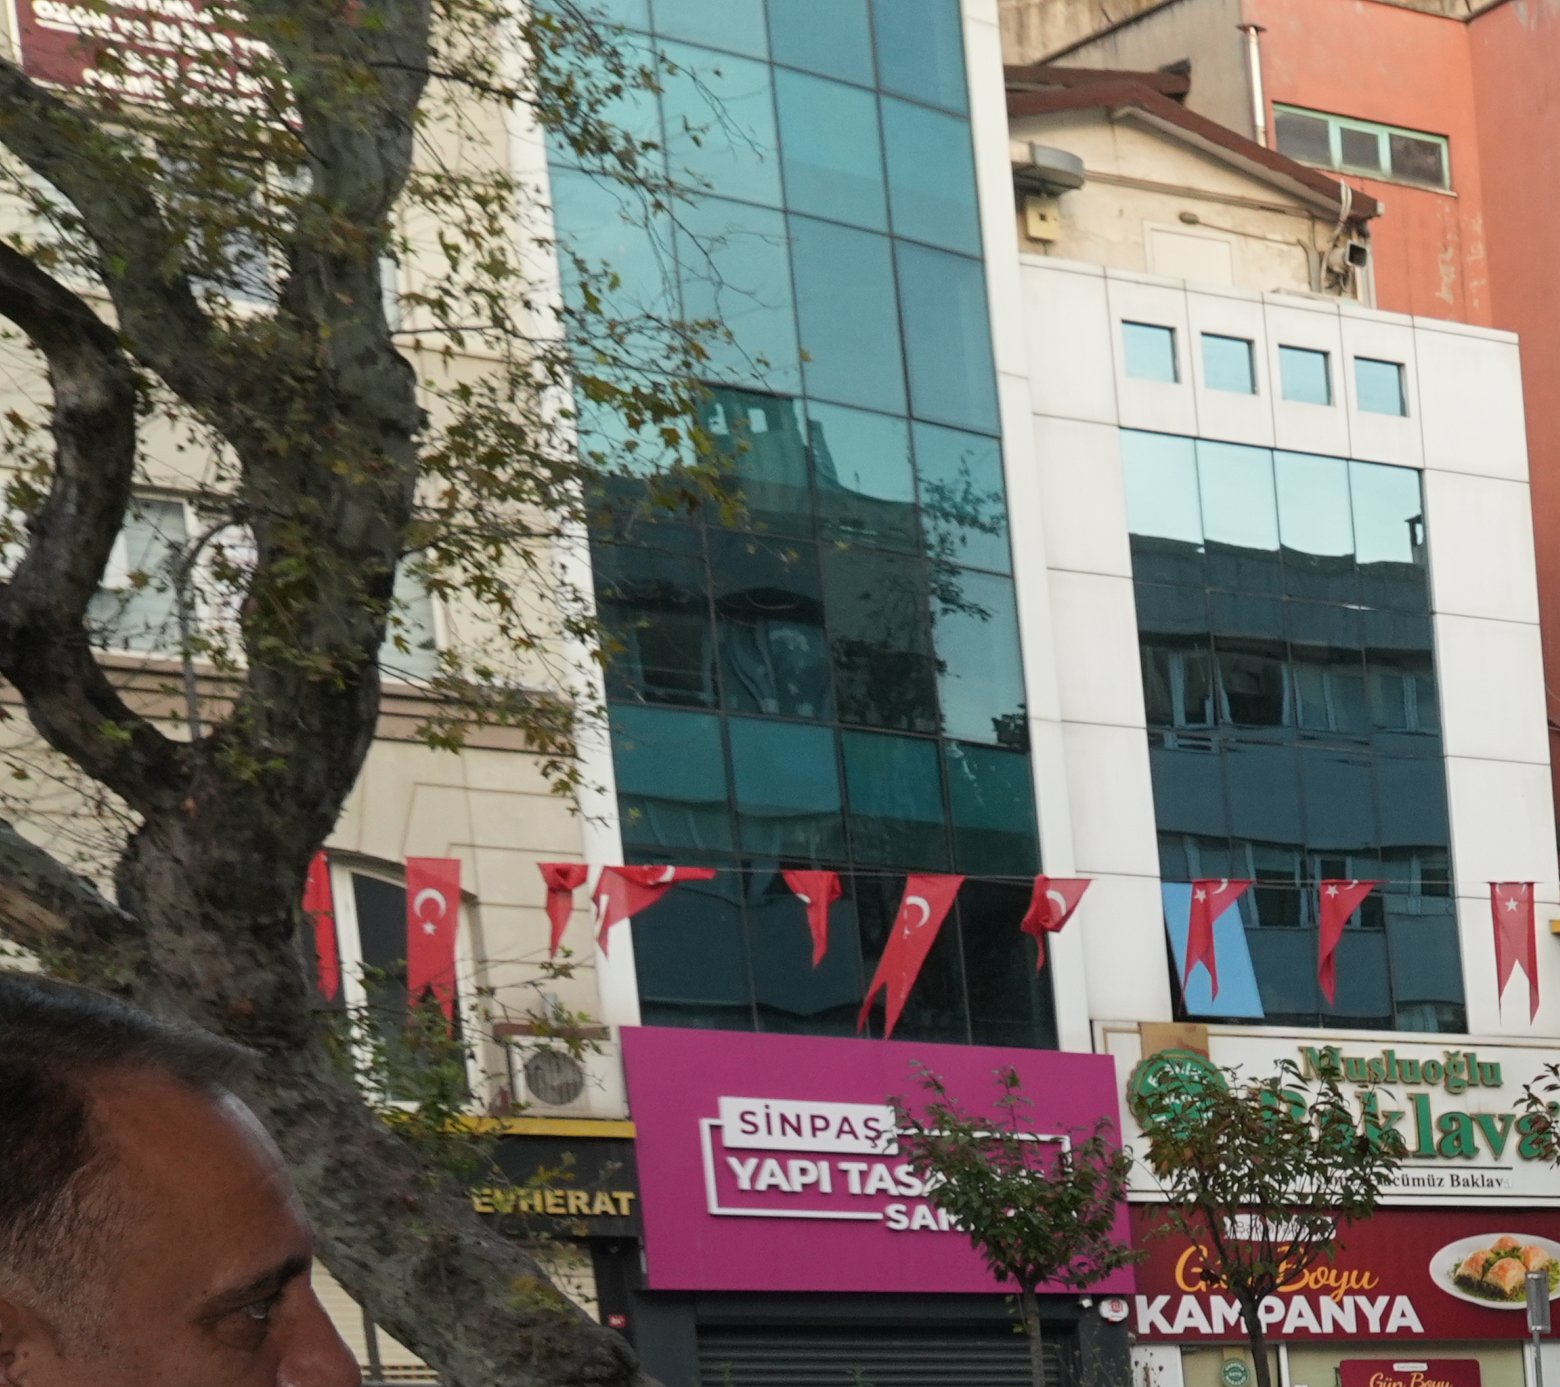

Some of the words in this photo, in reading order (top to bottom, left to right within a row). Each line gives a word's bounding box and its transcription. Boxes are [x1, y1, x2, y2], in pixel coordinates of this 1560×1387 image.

[1298, 1046, 1504, 1095] Musluoğlu
[739, 1104, 882, 1149] SİNPAŞ
[726, 1156, 832, 1194] YAPI
[1134, 1294, 1425, 1335] KAMPANYA
